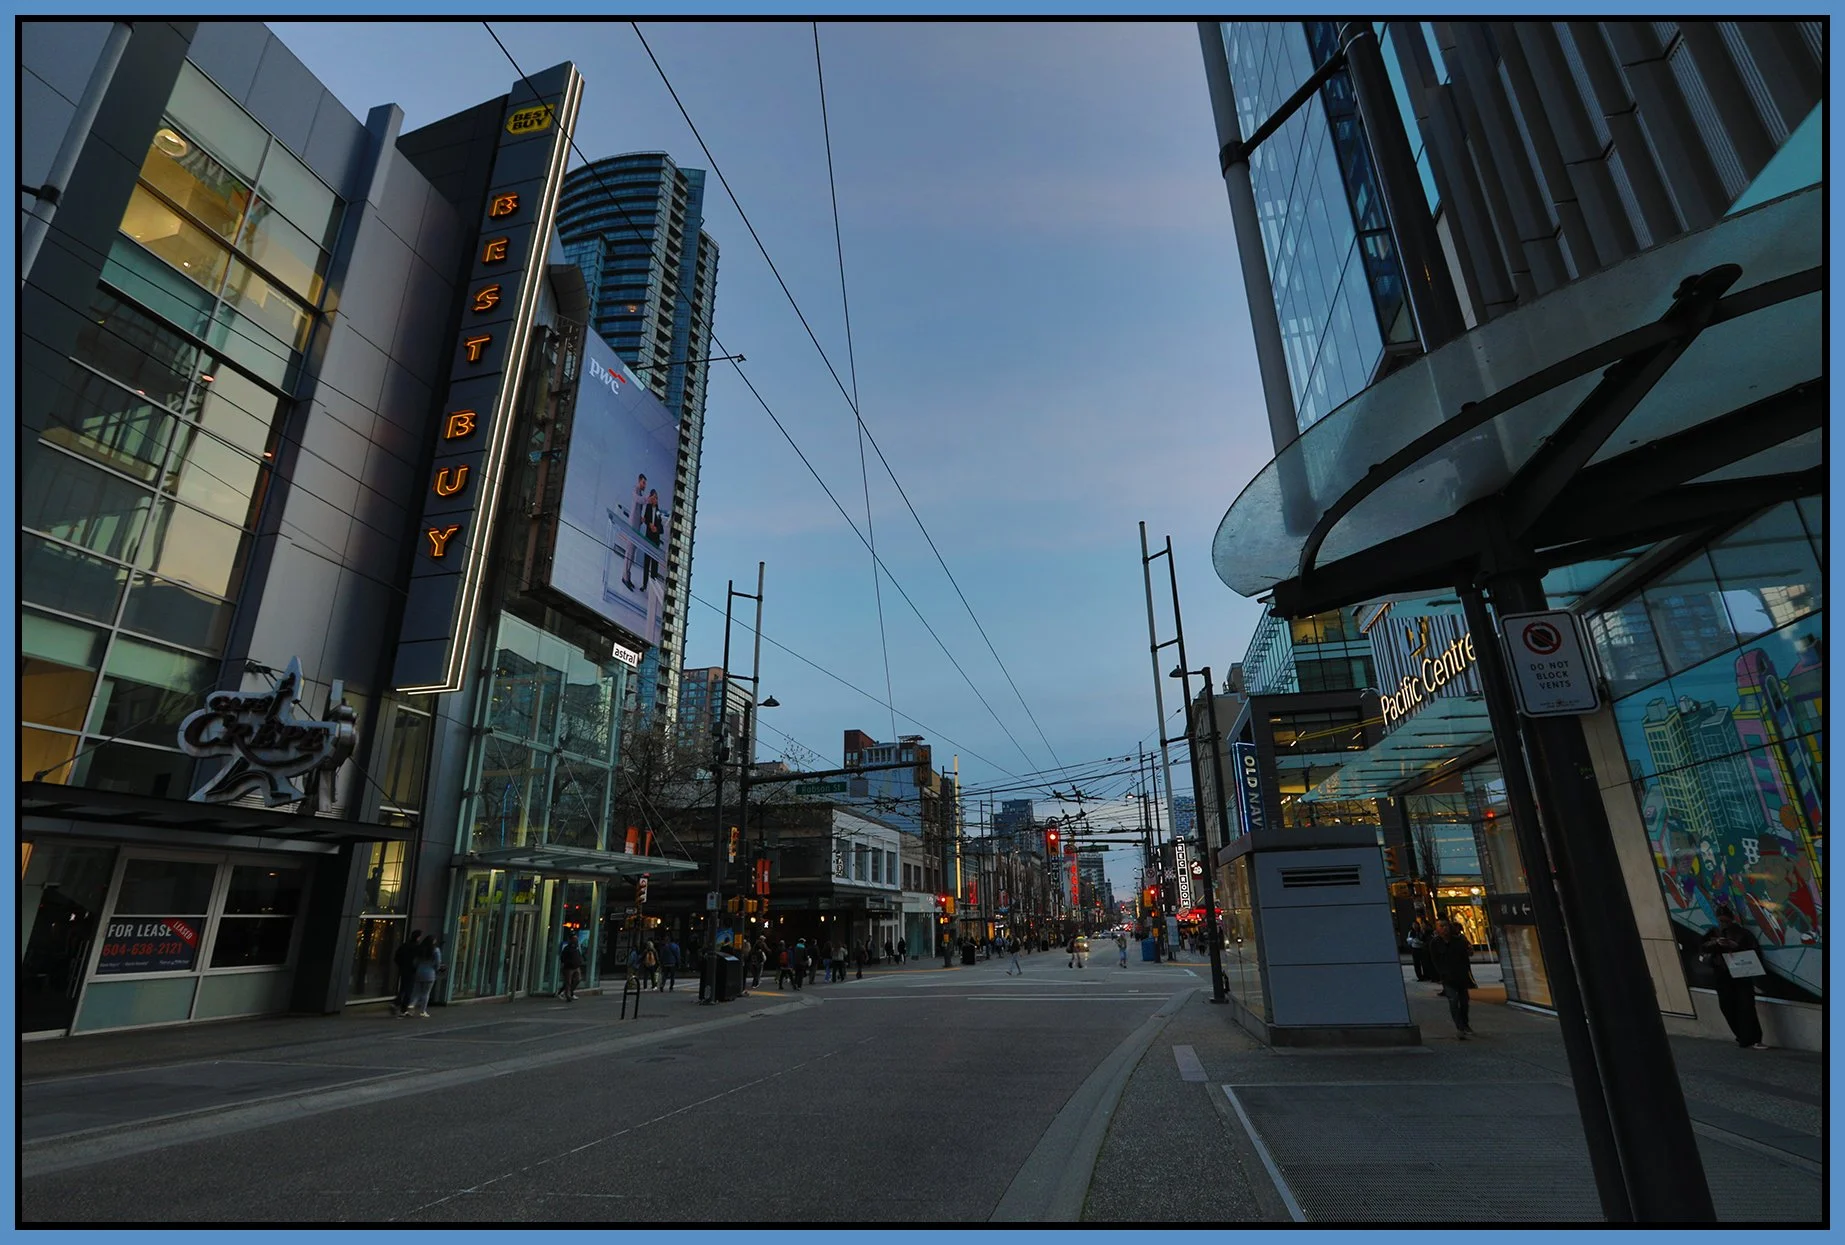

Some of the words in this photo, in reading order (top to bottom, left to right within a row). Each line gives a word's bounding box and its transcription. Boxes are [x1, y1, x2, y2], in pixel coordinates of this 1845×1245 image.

[513, 109, 550, 121] BEST
[512, 119, 543, 130] BUY
[464, 192, 520, 362] BEST
[589, 356, 620, 395] pwc
[429, 410, 477, 558] BUY
[614, 648, 636, 664] astral
[1530, 663, 1545, 671] DO
[1549, 660, 1569, 669] NOT
[1381, 675, 1422, 726] Pacific
[1422, 632, 1477, 693] Centre
[1536, 671, 1569, 680] BLOCK
[1539, 681, 1572, 690] VENTS
[1243, 755, 1258, 788] OLD
[1248, 792, 1265, 830] NAV
[107, 924, 134, 938] FOR
[136, 923, 172, 937] LEASE
[173, 920, 193, 941] LEASED
